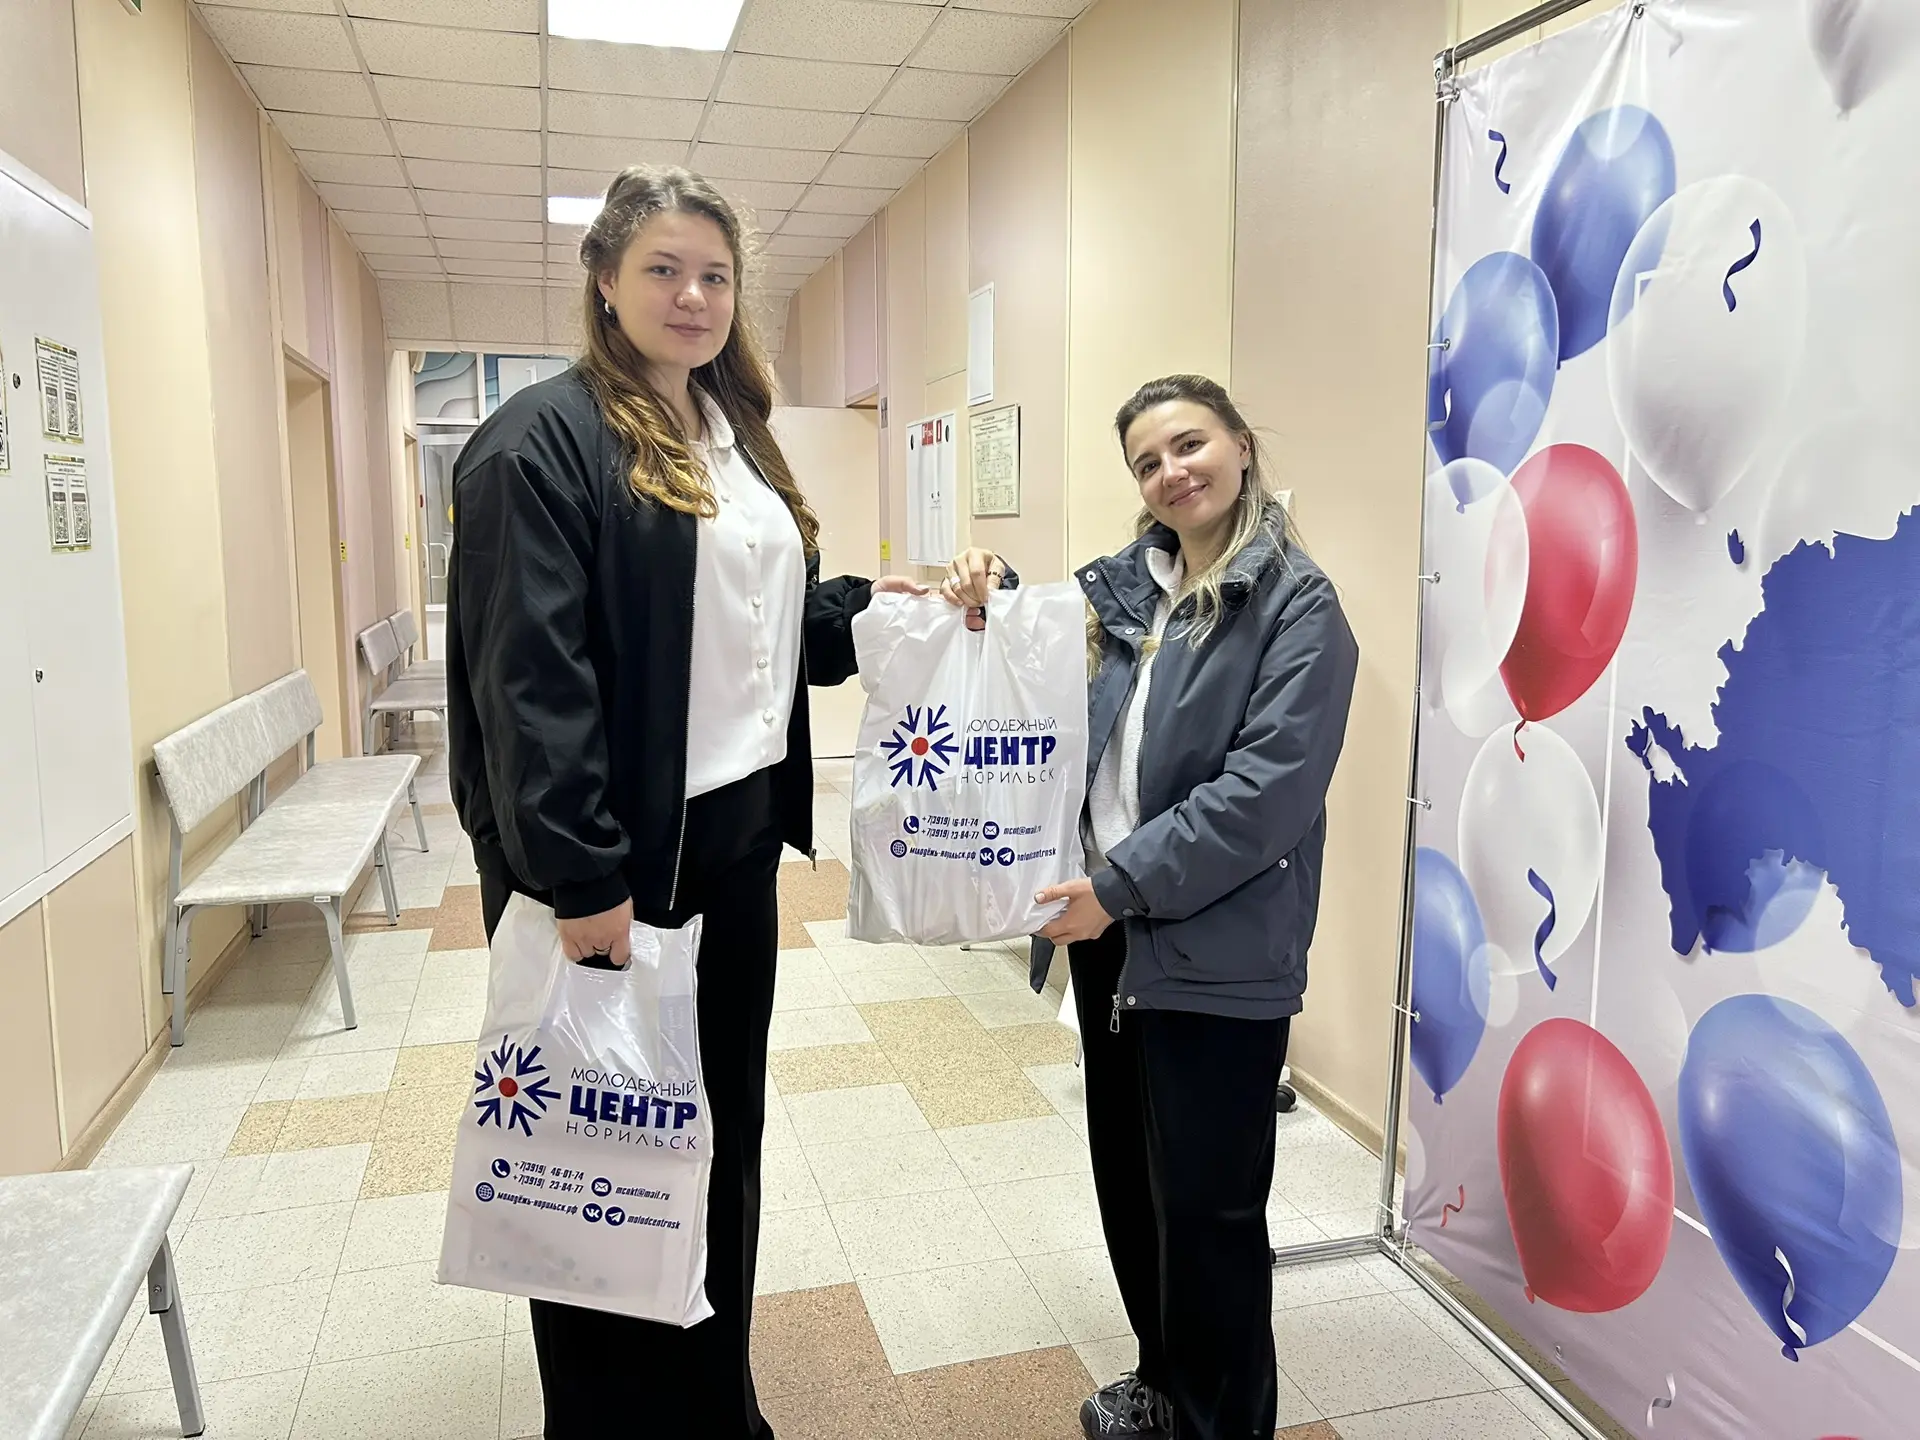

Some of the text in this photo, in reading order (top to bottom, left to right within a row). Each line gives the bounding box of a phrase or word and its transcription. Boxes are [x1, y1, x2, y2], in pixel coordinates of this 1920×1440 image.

[964, 735, 1056, 769] ЦЕНТР
[961, 767, 1055, 784] НОРИЛЬСК
[570, 1067, 697, 1097] МОЛОДЕЖНЫЙ
[569, 1085, 697, 1129] ЦЕНТР
[566, 1121, 697, 1150] НОРИЛЬСК
[549, 1180, 584, 1194] 23-84-77
[550, 1167, 585, 1181] 46-01-74
